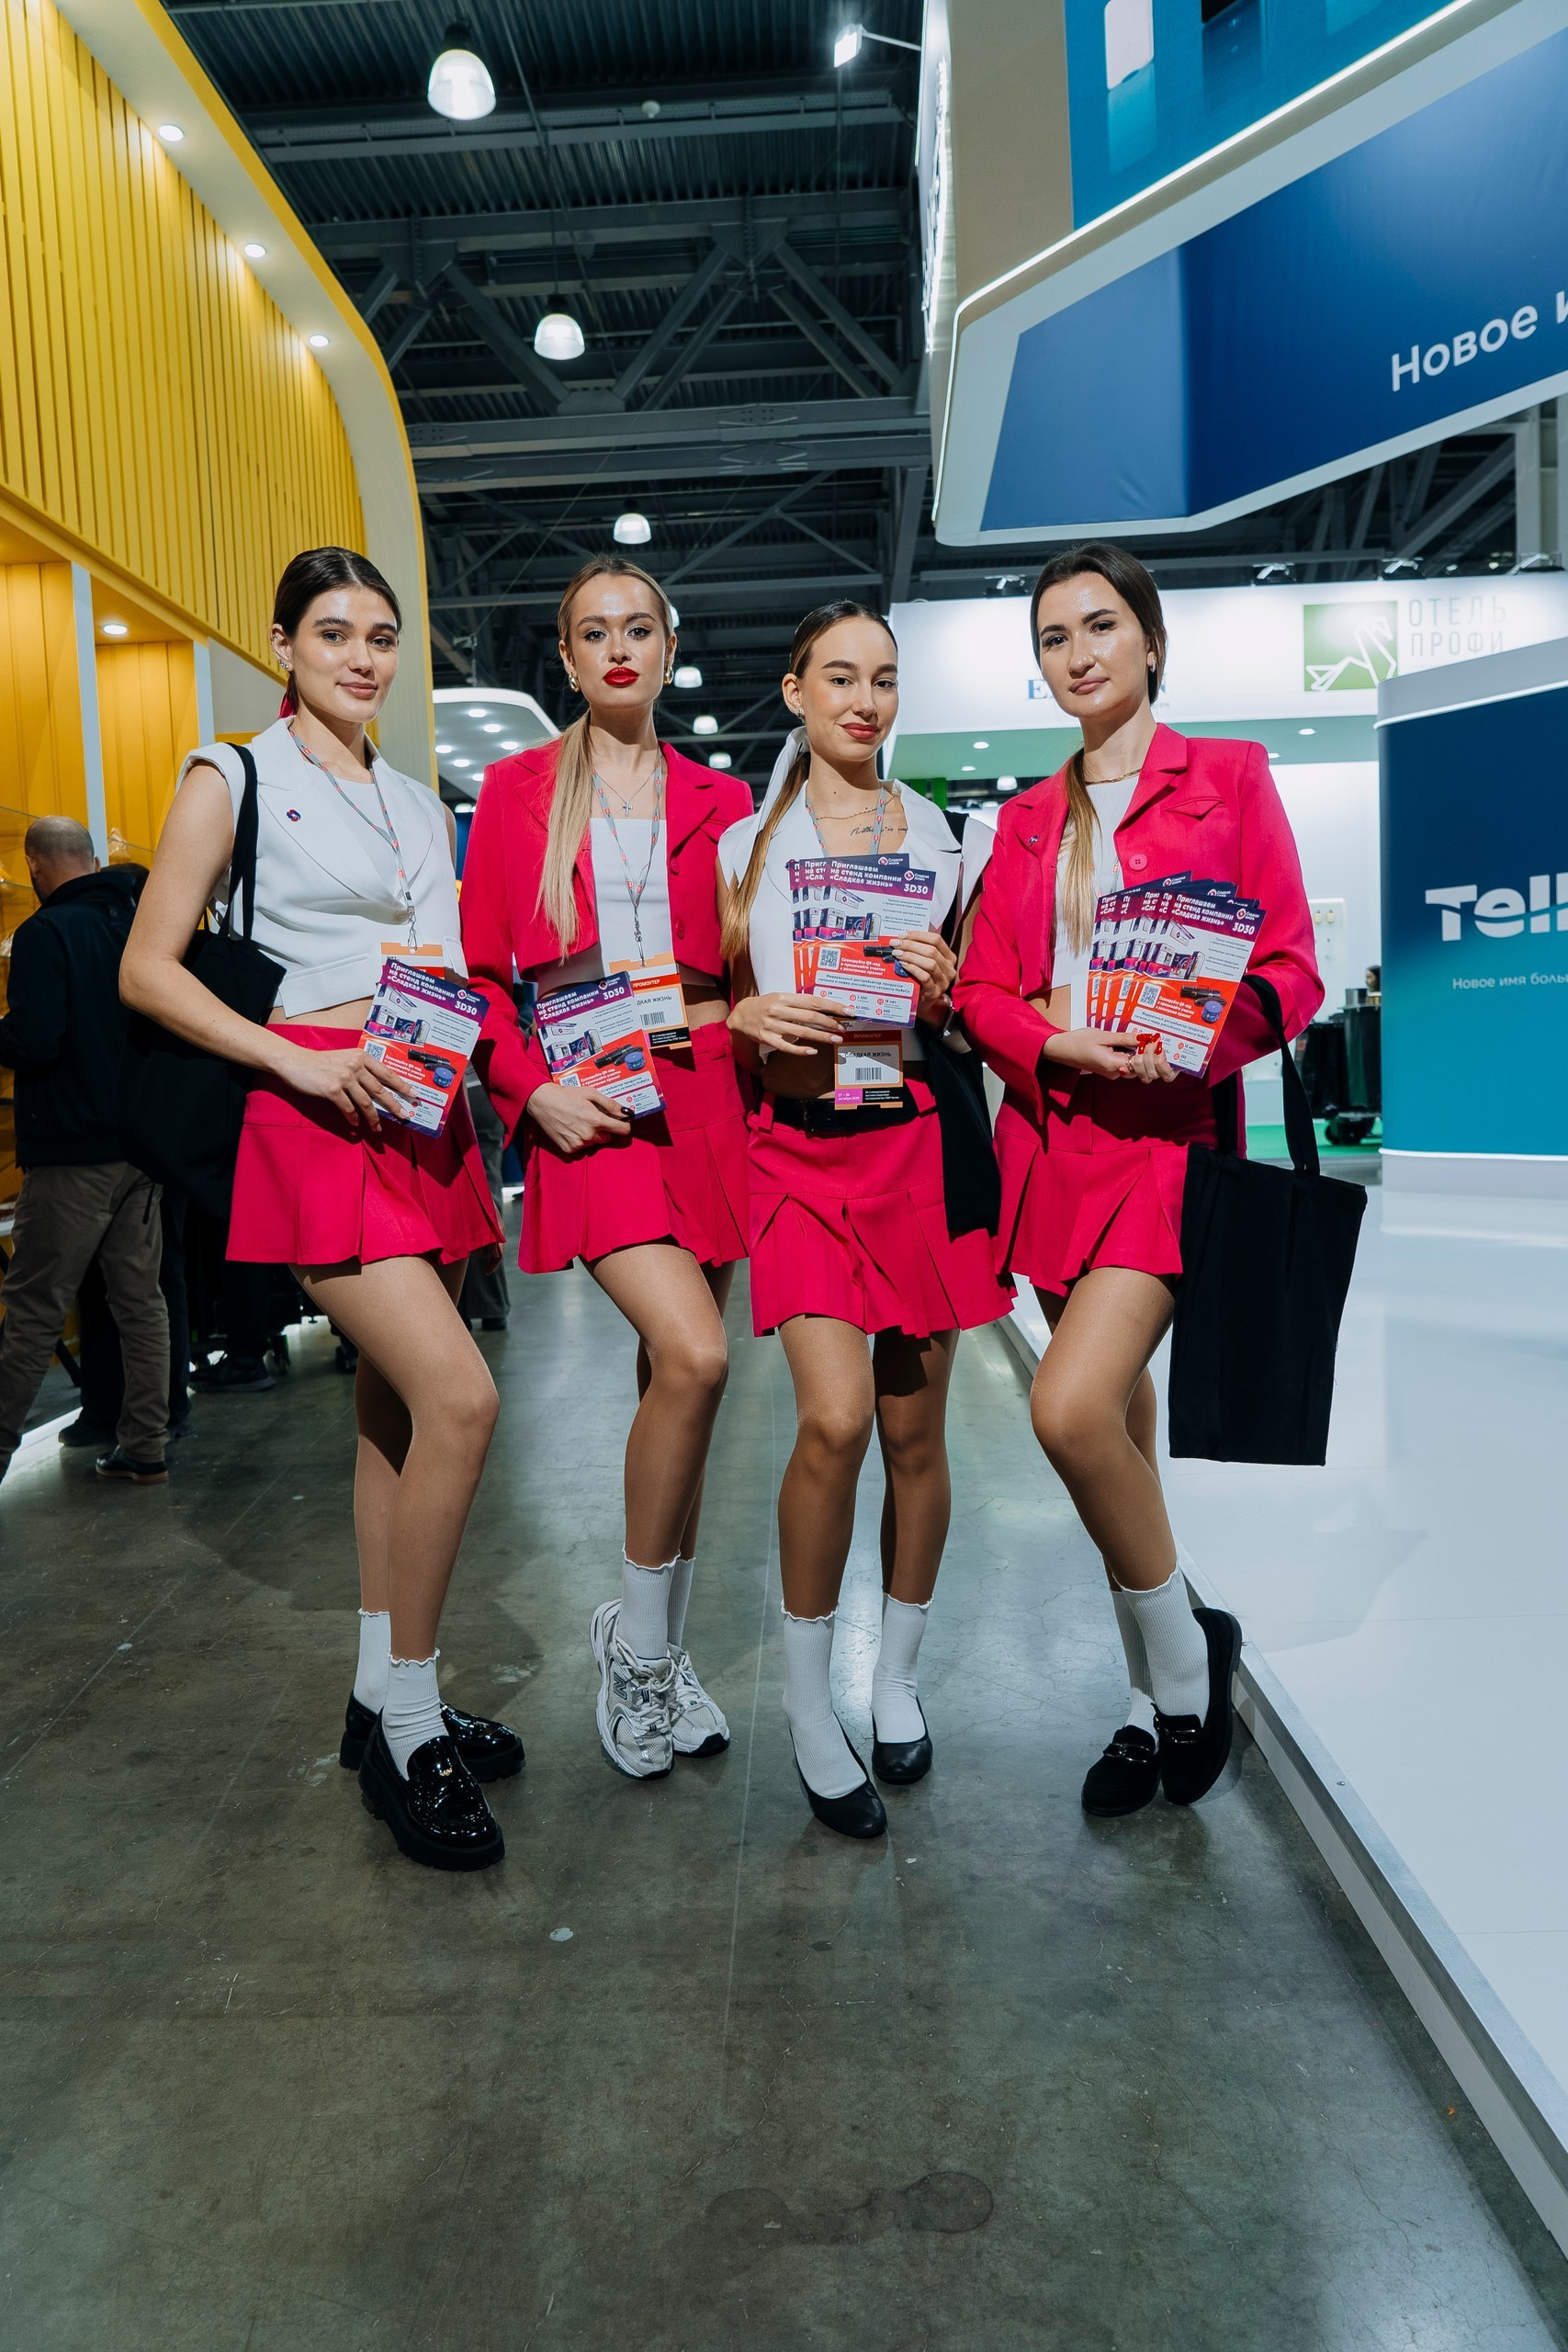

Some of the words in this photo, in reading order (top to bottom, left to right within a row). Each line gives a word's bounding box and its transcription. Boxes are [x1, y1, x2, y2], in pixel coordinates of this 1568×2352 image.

[1392, 305, 1539, 392] Новое
[1409, 595, 1506, 627] ОТЕЛЬ
[1411, 629, 1503, 657] ПРОФИ
[832, 861, 878, 873] Приглашаем
[830, 875, 864, 884] «Сладкая
[864, 873, 902, 882] компании
[904, 883, 928, 895] 3D30
[1176, 894, 1216, 909] Приглашаем
[1172, 909, 1200, 920] «Сладкая
[1201, 916, 1224, 925] жизнь»
[1183, 904, 1201, 913] стенд
[1202, 908, 1234, 921] компании
[1232, 922, 1255, 935] 3D30
[391, 962, 435, 984] Приглашаем
[1452, 978, 1495, 989] Новое
[1499, 976, 1526, 986] имя
[1530, 972, 1568, 985] боль
[388, 974, 420, 991] «Сладкая
[421, 988, 446, 1001] жизнь»
[399, 972, 420, 986] стенд
[420, 980, 455, 999] компании
[633, 979, 660, 988] ПРОМОУТЕР
[537, 992, 577, 1010] Приглашаем
[548, 1002, 566, 1013] стенд
[567, 990, 599, 1005] компании
[603, 987, 624, 1000] 3D30
[455, 1001, 477, 1015] 3D30
[540, 1007, 570, 1020] «Сладкая
[571, 998, 594, 1010] жизнь»
